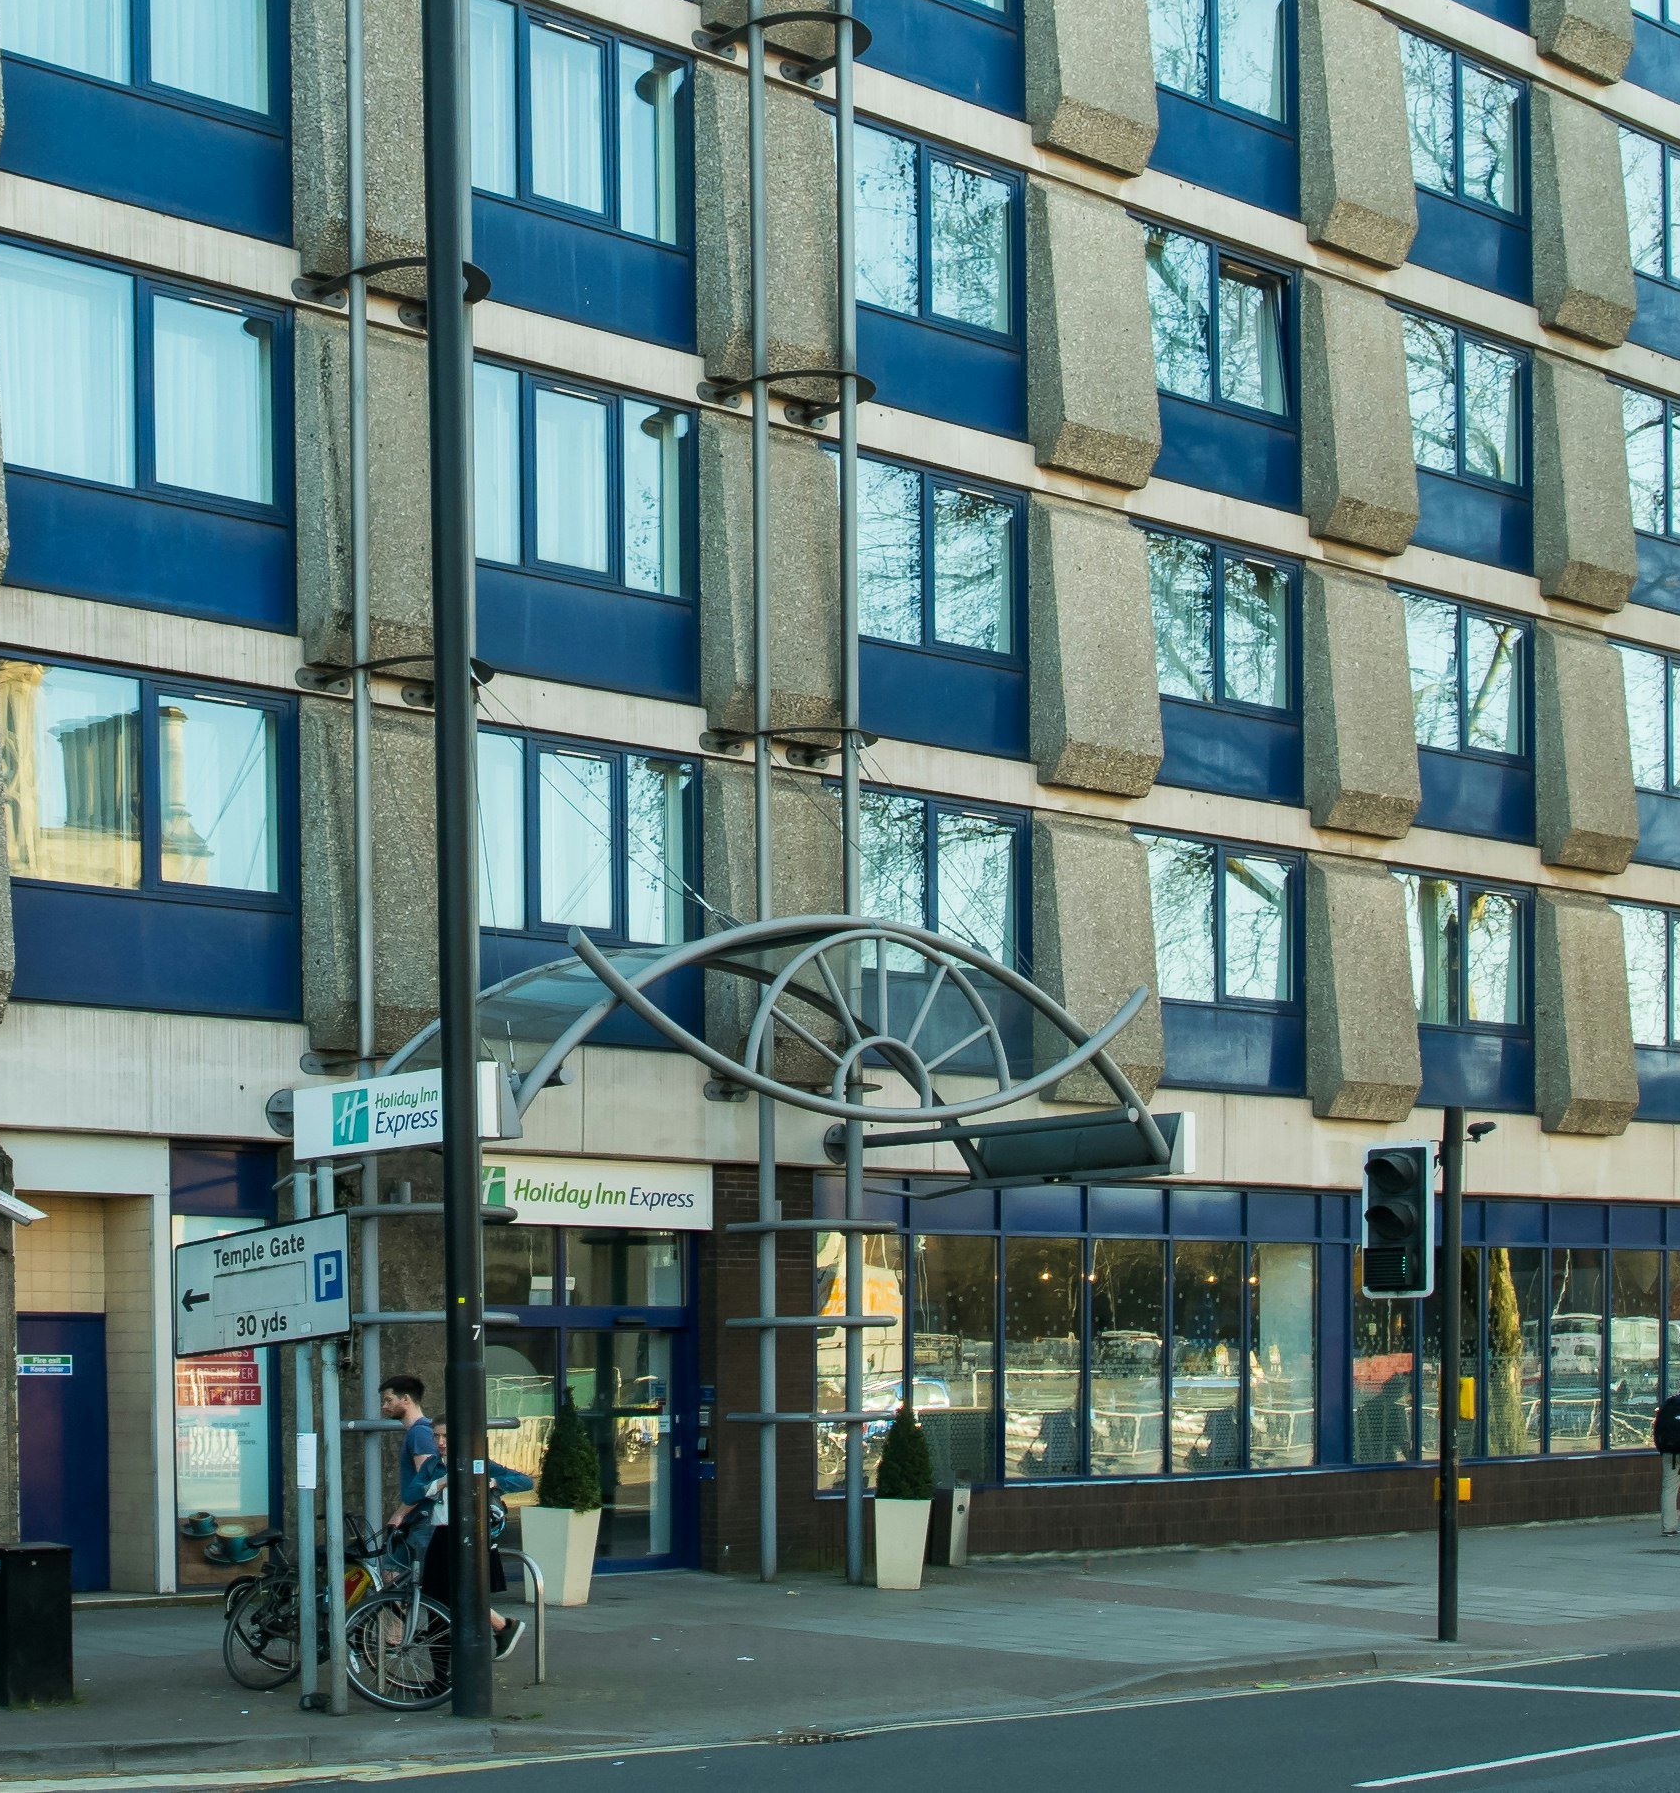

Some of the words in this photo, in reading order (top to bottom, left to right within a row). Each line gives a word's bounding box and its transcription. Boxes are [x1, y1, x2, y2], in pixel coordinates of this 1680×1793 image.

[374, 1089, 419, 1109] Holiday
[420, 1086, 438, 1103] Inn
[375, 1109, 439, 1138] Express
[513, 1178, 593, 1210] Holiday
[595, 1182, 626, 1206] Inn
[629, 1186, 695, 1212] Express
[213, 1241, 265, 1269] Temple
[270, 1233, 305, 1257] Gate
[319, 1256, 337, 1298] P
[236, 1314, 257, 1338] 30
[260, 1311, 288, 1338] yds
[471, 1324, 481, 1341] 7
[29, 1366, 47, 1374] Keep
[32, 1356, 47, 1364] Fire
[219, 1389, 257, 1401] COFFEE
